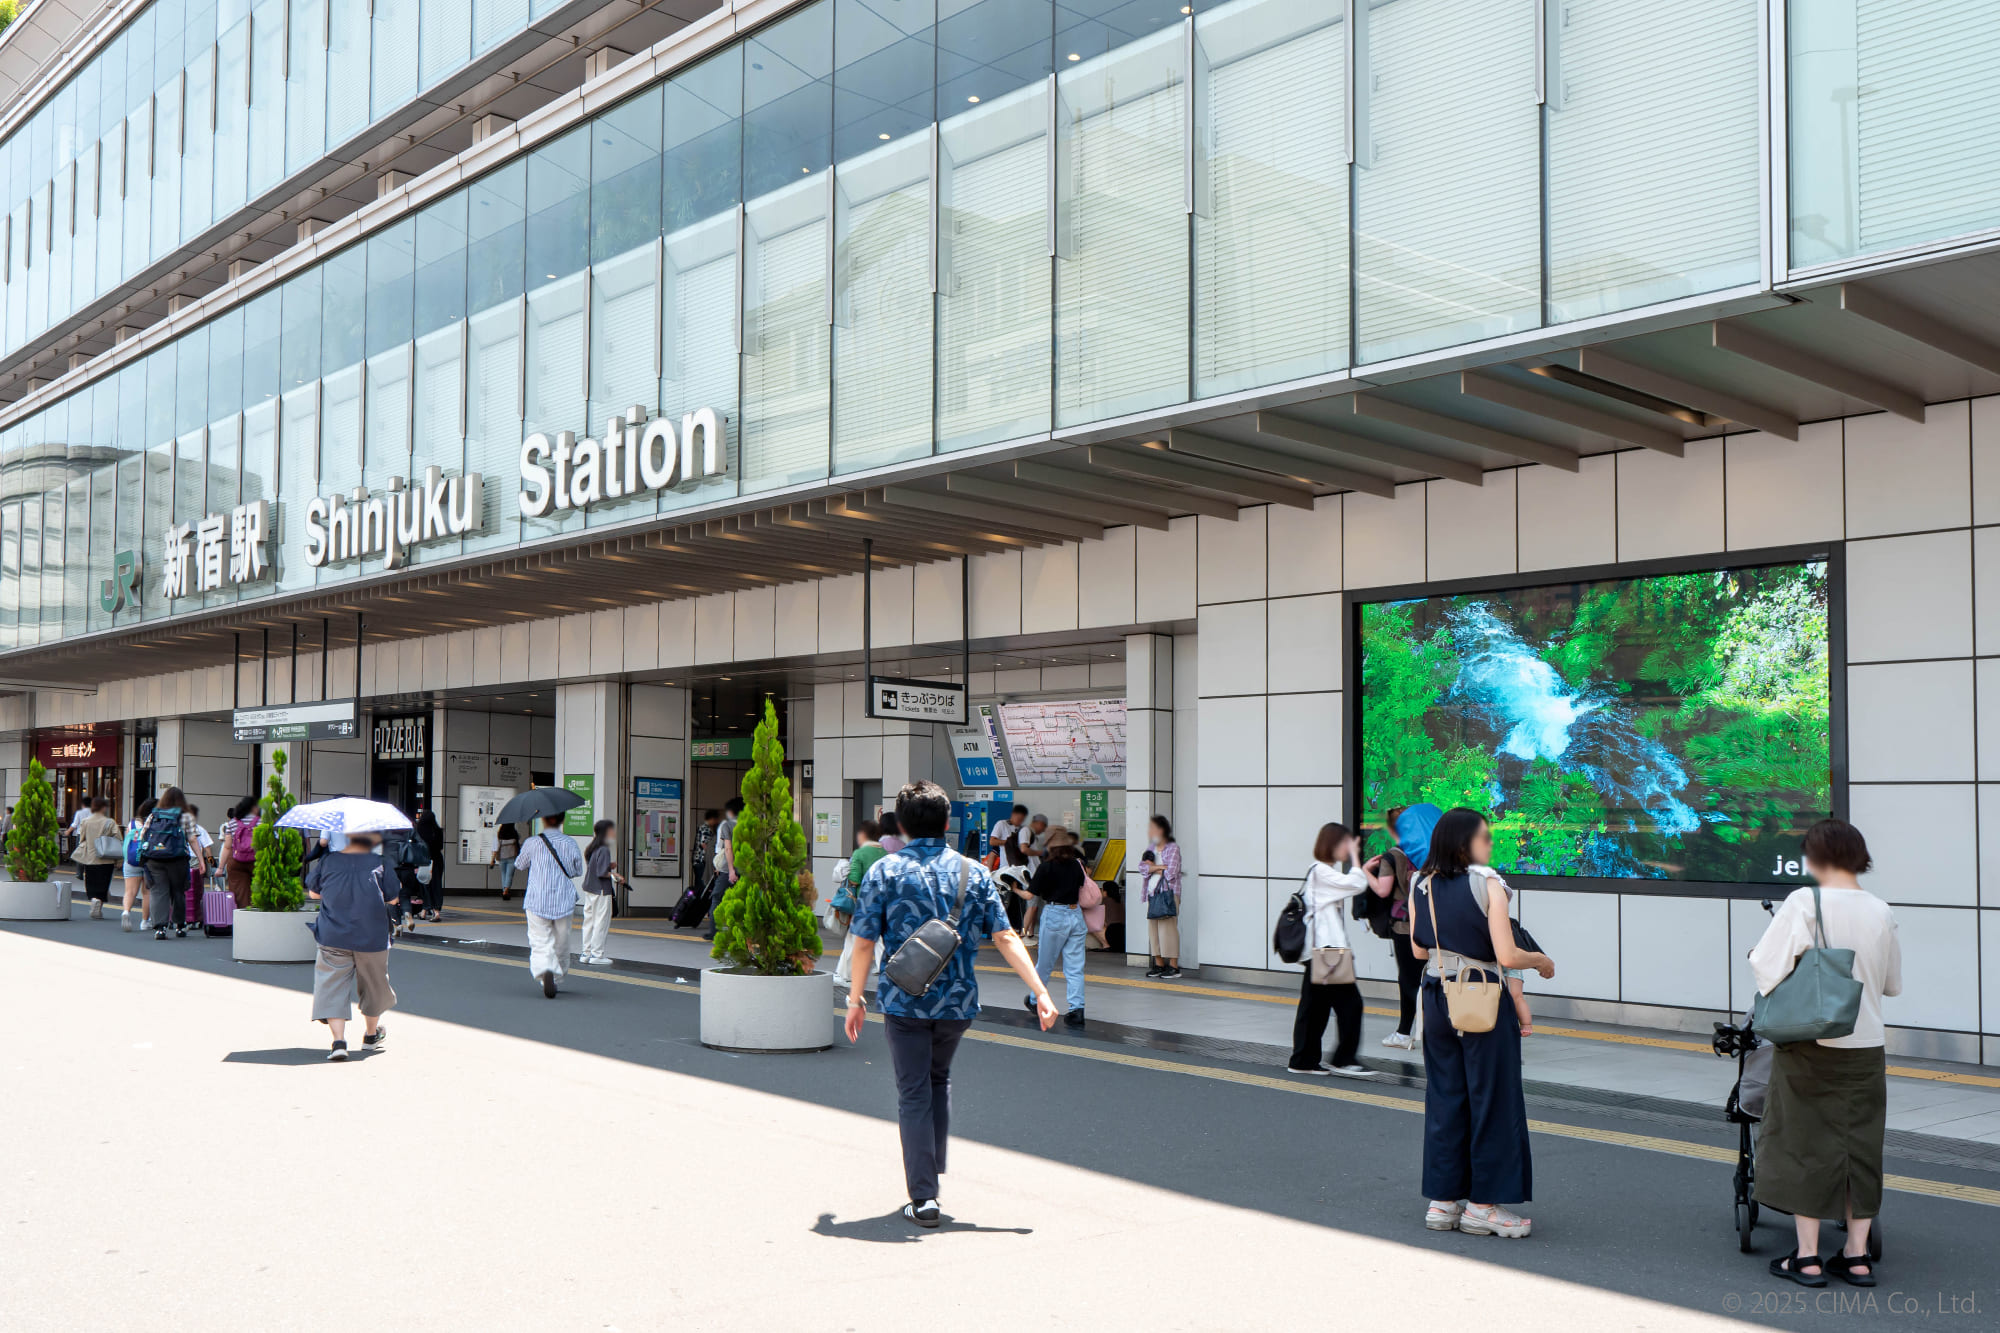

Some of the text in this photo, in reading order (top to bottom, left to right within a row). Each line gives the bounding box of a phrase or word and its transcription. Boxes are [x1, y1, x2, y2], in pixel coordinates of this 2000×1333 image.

[100, 404, 729, 614] JR 新宿駅 Shinjuku Station
[900, 691, 955, 707] きっぷうりば
[374, 725, 425, 753] PIZZERIA
[963, 742, 980, 752] ATM
